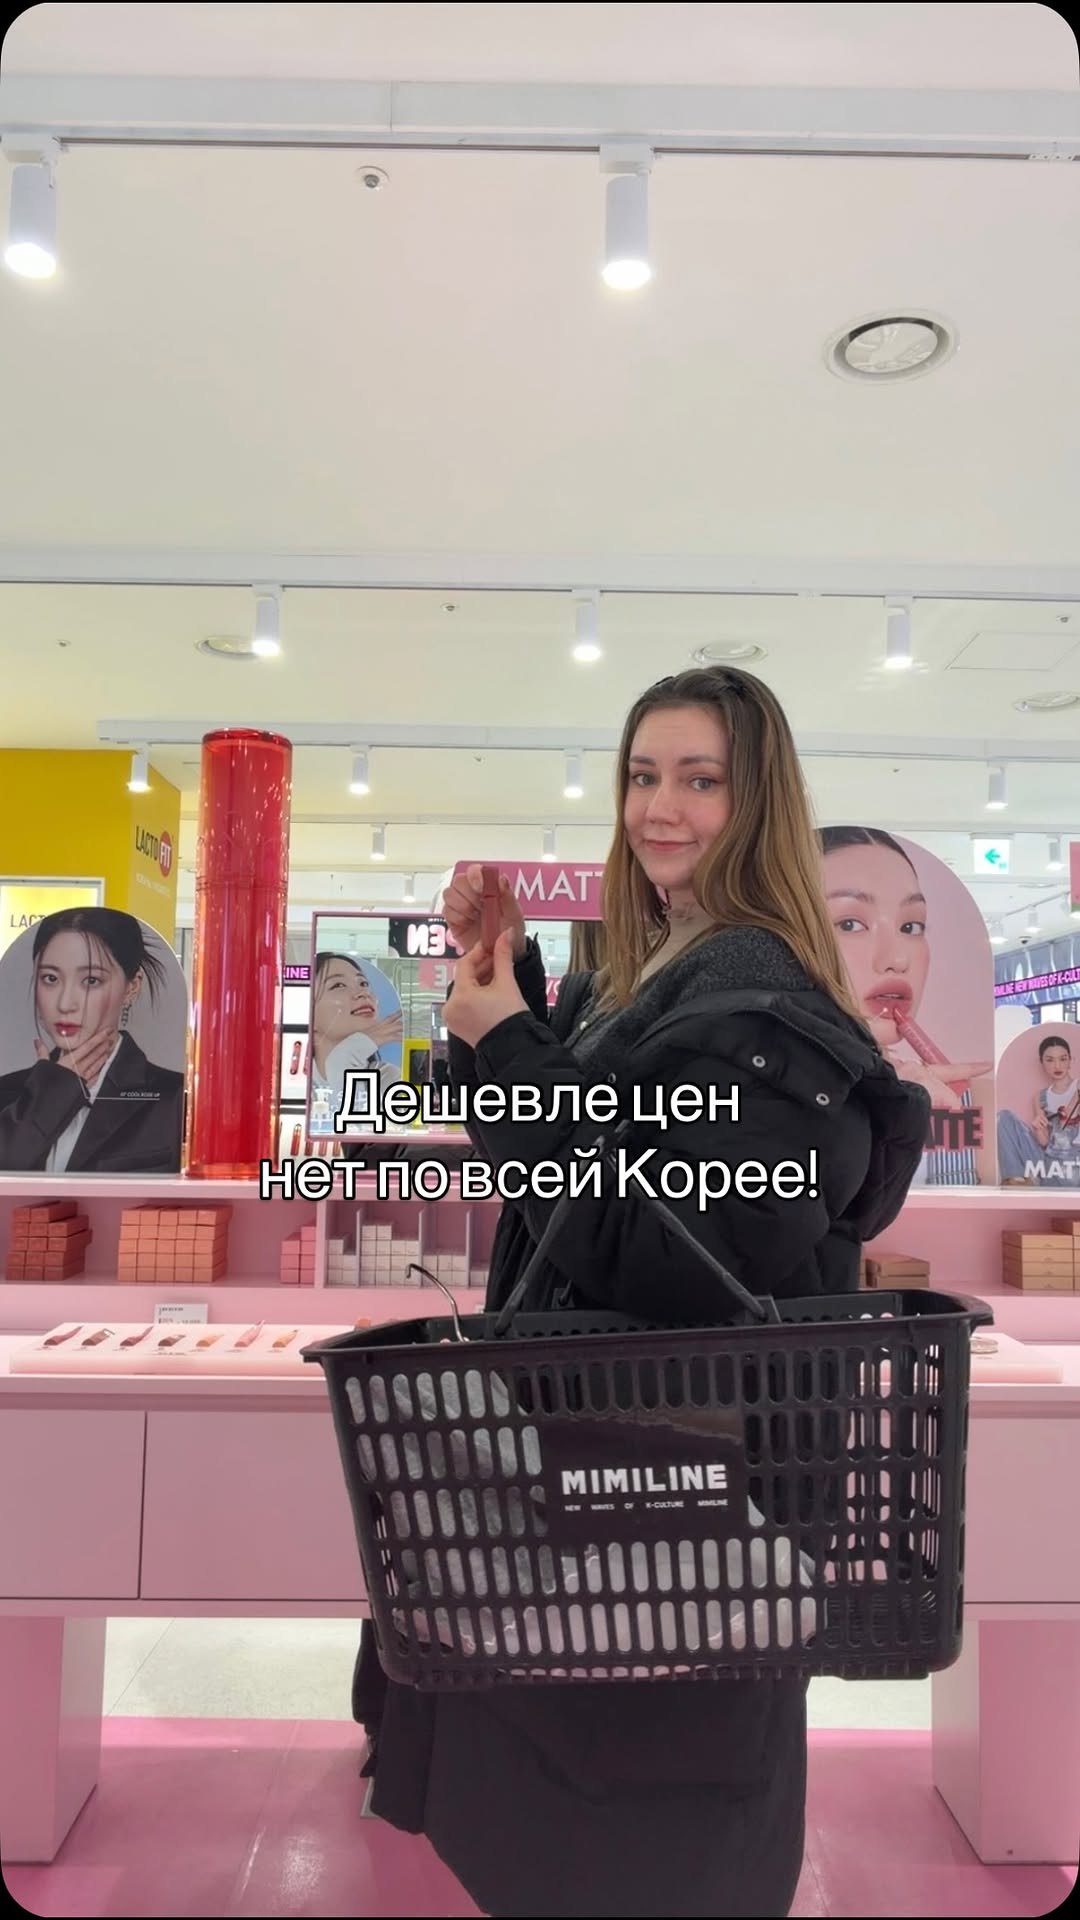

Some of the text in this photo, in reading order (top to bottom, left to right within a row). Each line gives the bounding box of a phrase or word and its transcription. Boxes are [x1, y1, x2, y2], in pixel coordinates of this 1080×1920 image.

[135, 825, 171, 869] LACTO FIT
[283, 967, 309, 979] INE
[562, 1464, 727, 1495] MIMILINE
[591, 1503, 615, 1511] WAVES
[624, 1502, 634, 1510] OF
[646, 1500, 685, 1509] K-CULTURE
[697, 1499, 728, 1507] MIMILINE
